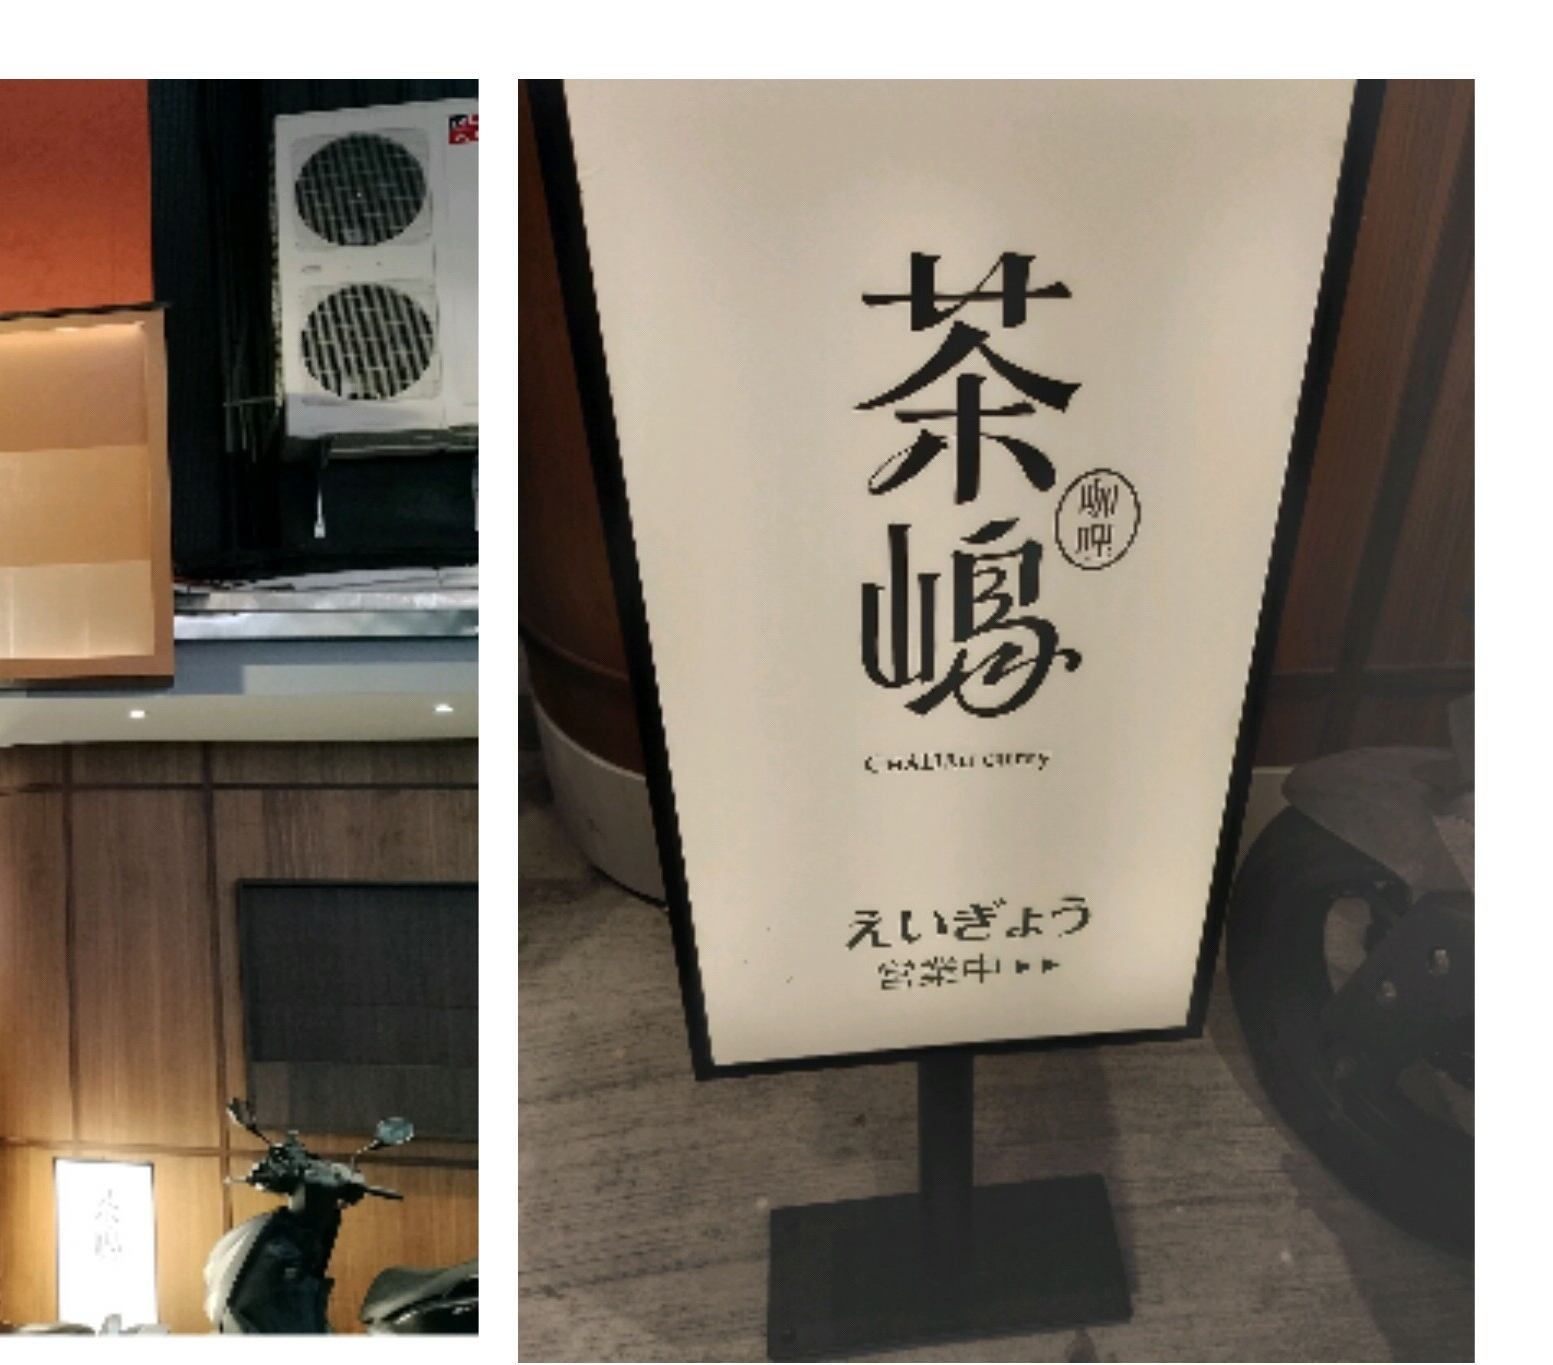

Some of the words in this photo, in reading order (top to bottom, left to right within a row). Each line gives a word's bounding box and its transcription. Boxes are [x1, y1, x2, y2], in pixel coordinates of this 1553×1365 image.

[846, 897, 1090, 951] えいぎょう
